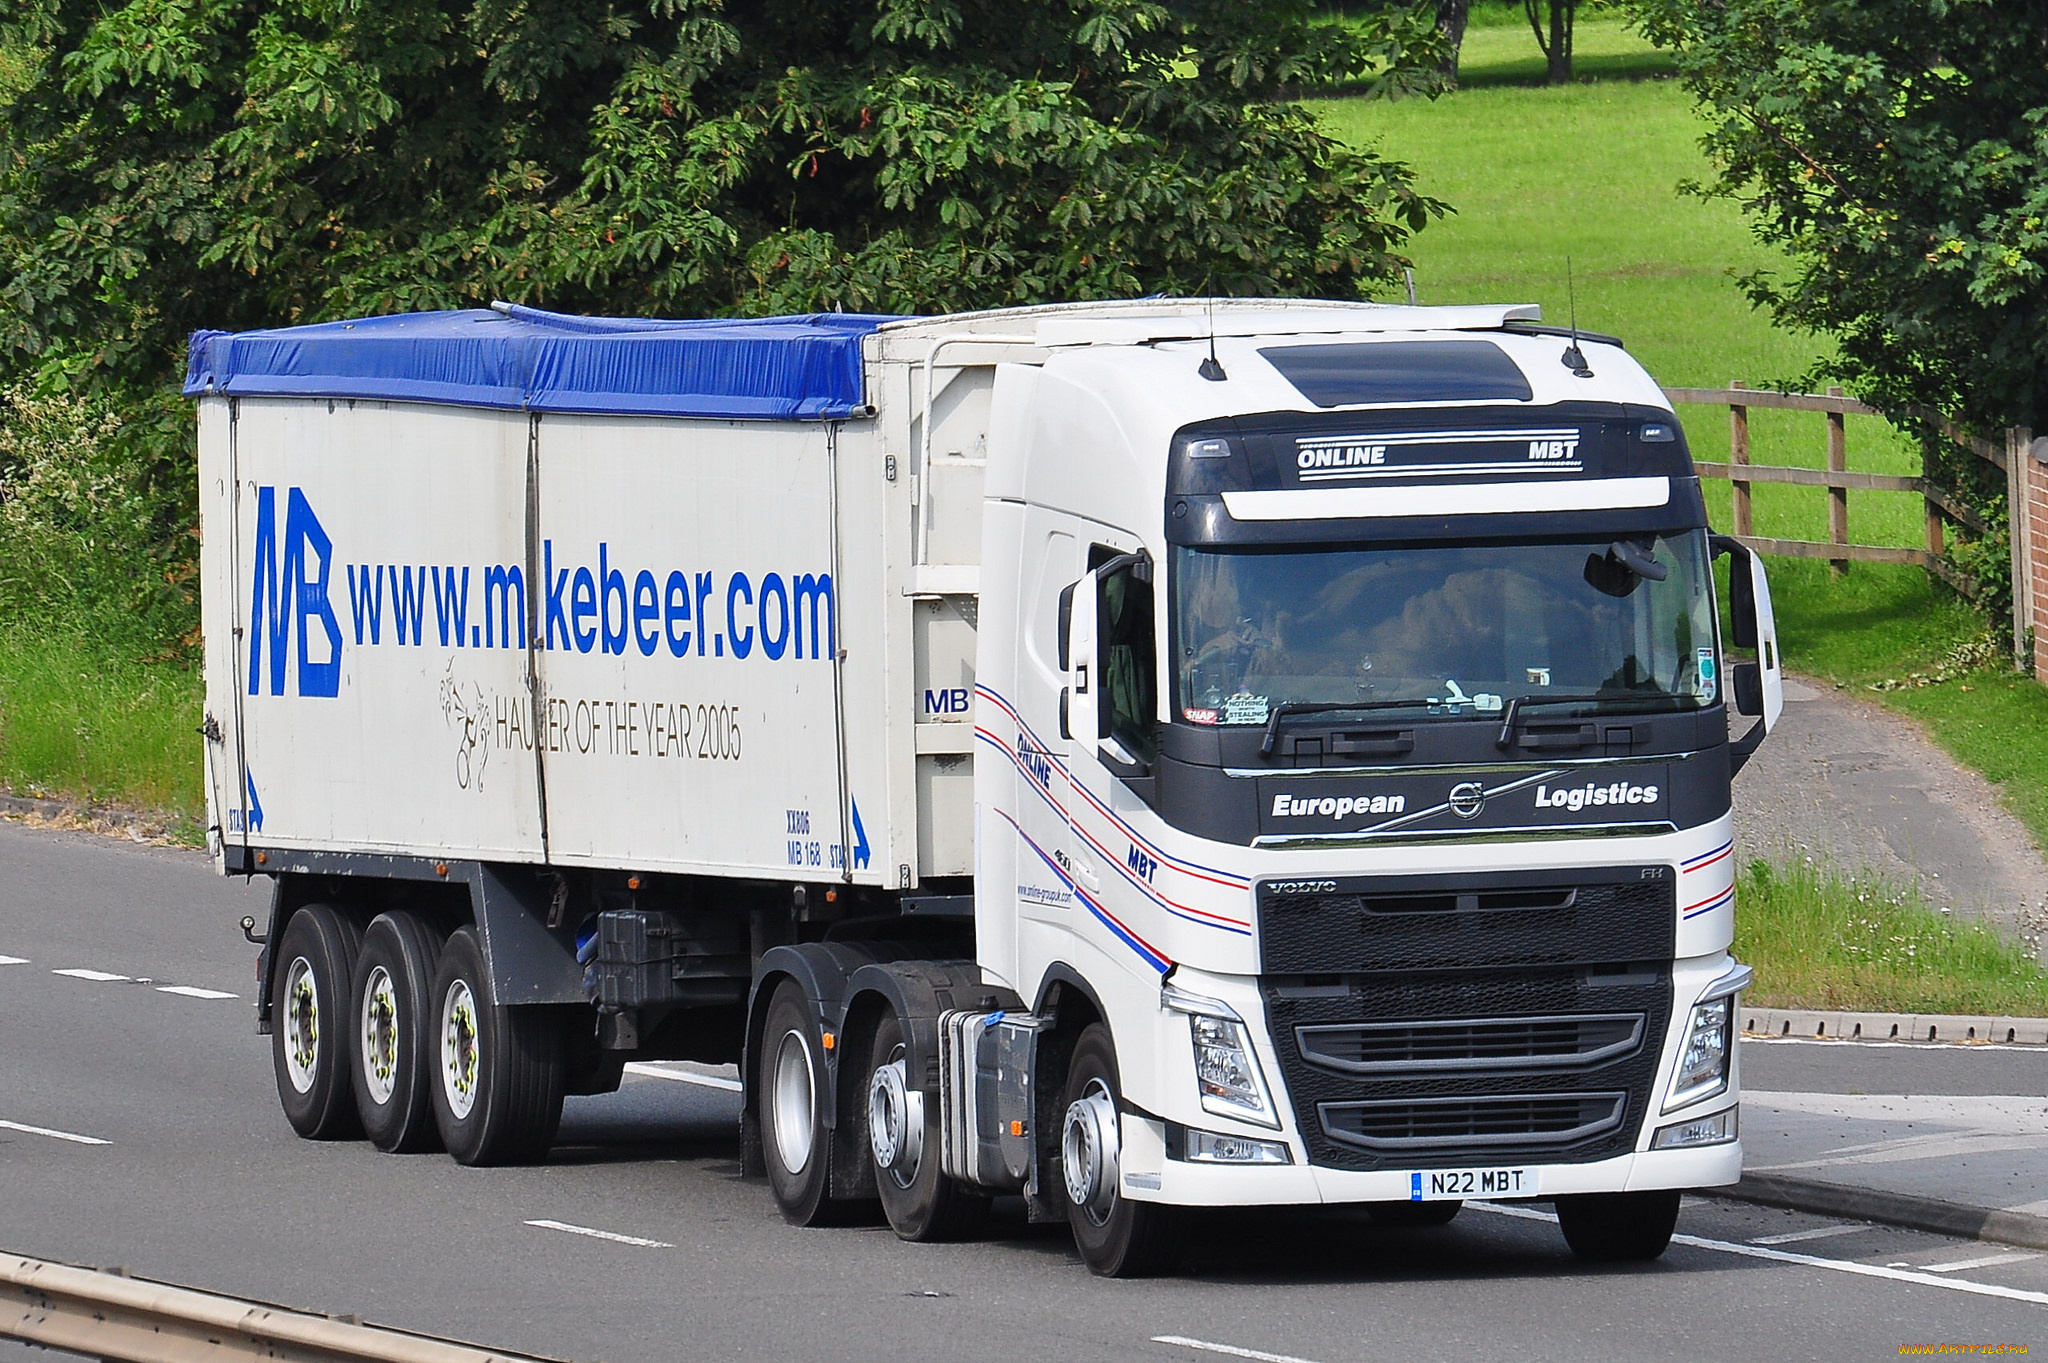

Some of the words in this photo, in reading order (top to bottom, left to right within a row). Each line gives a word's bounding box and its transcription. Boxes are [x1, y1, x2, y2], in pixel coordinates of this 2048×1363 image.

[1297, 446, 1386, 468] ONLINE
[1528, 441, 1579, 459] MBT
[347, 539, 834, 661] www.mkebeer.com
[924, 688, 970, 713] MB
[575, 699, 601, 754] OF
[605, 701, 639, 756] THE
[642, 702, 692, 758] YEAR
[696, 703, 742, 761] 2005
[1017, 732, 1052, 790] ONLINE
[1271, 794, 1405, 820] European
[1535, 782, 1659, 810] Logistics
[787, 841, 802, 865] MB
[804, 841, 820, 866] 168
[1127, 843, 1158, 884] MBT
[1266, 880, 1337, 894] VOLVO
[1641, 868, 1663, 879] FH
[1432, 1172, 1475, 1194] N22
[1482, 1170, 1523, 1192] MBT
